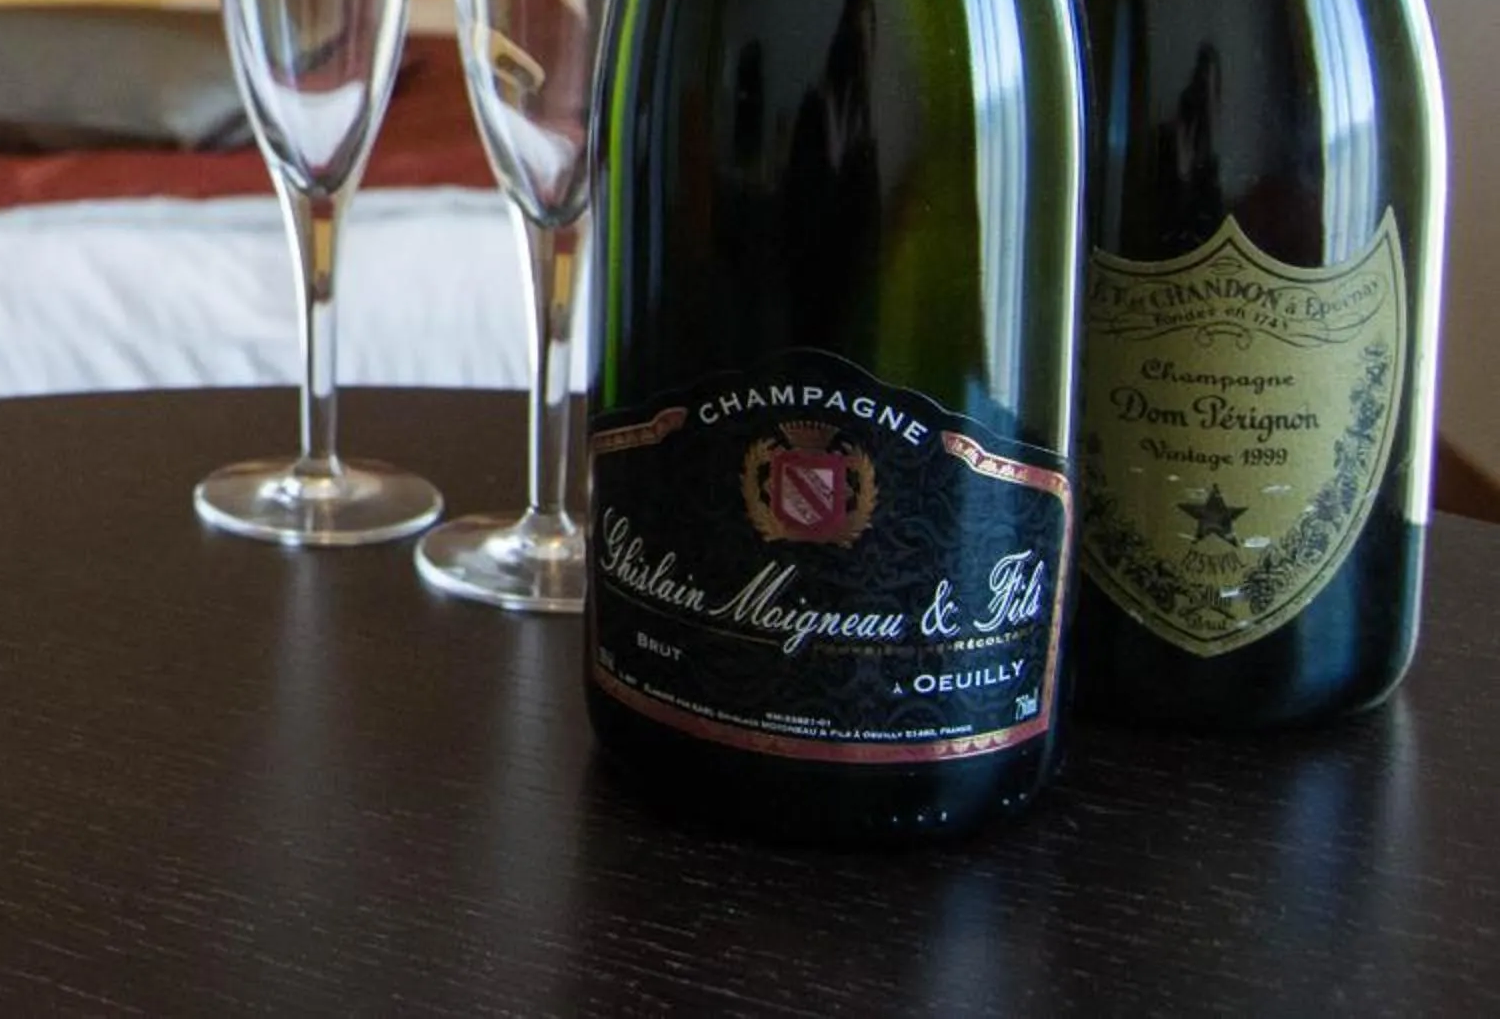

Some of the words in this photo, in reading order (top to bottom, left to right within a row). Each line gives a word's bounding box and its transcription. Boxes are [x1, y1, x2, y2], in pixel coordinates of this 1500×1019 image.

[1149, 278, 1280, 311] CHANDON
[1140, 357, 1296, 395] Champagne
[699, 384, 929, 446] CHAMPAGNE
[1109, 385, 1189, 428] Dom
[1192, 394, 1321, 443] Pérignon
[1138, 437, 1235, 471] Vintage
[1241, 447, 1289, 467] 1999
[600, 506, 705, 612] Ghislain
[708, 560, 903, 653] Moigneau
[920, 578, 961, 637] &
[973, 548, 1045, 632] Fils
[636, 631, 683, 661] BRUT
[912, 658, 1025, 693] OEUILLY
